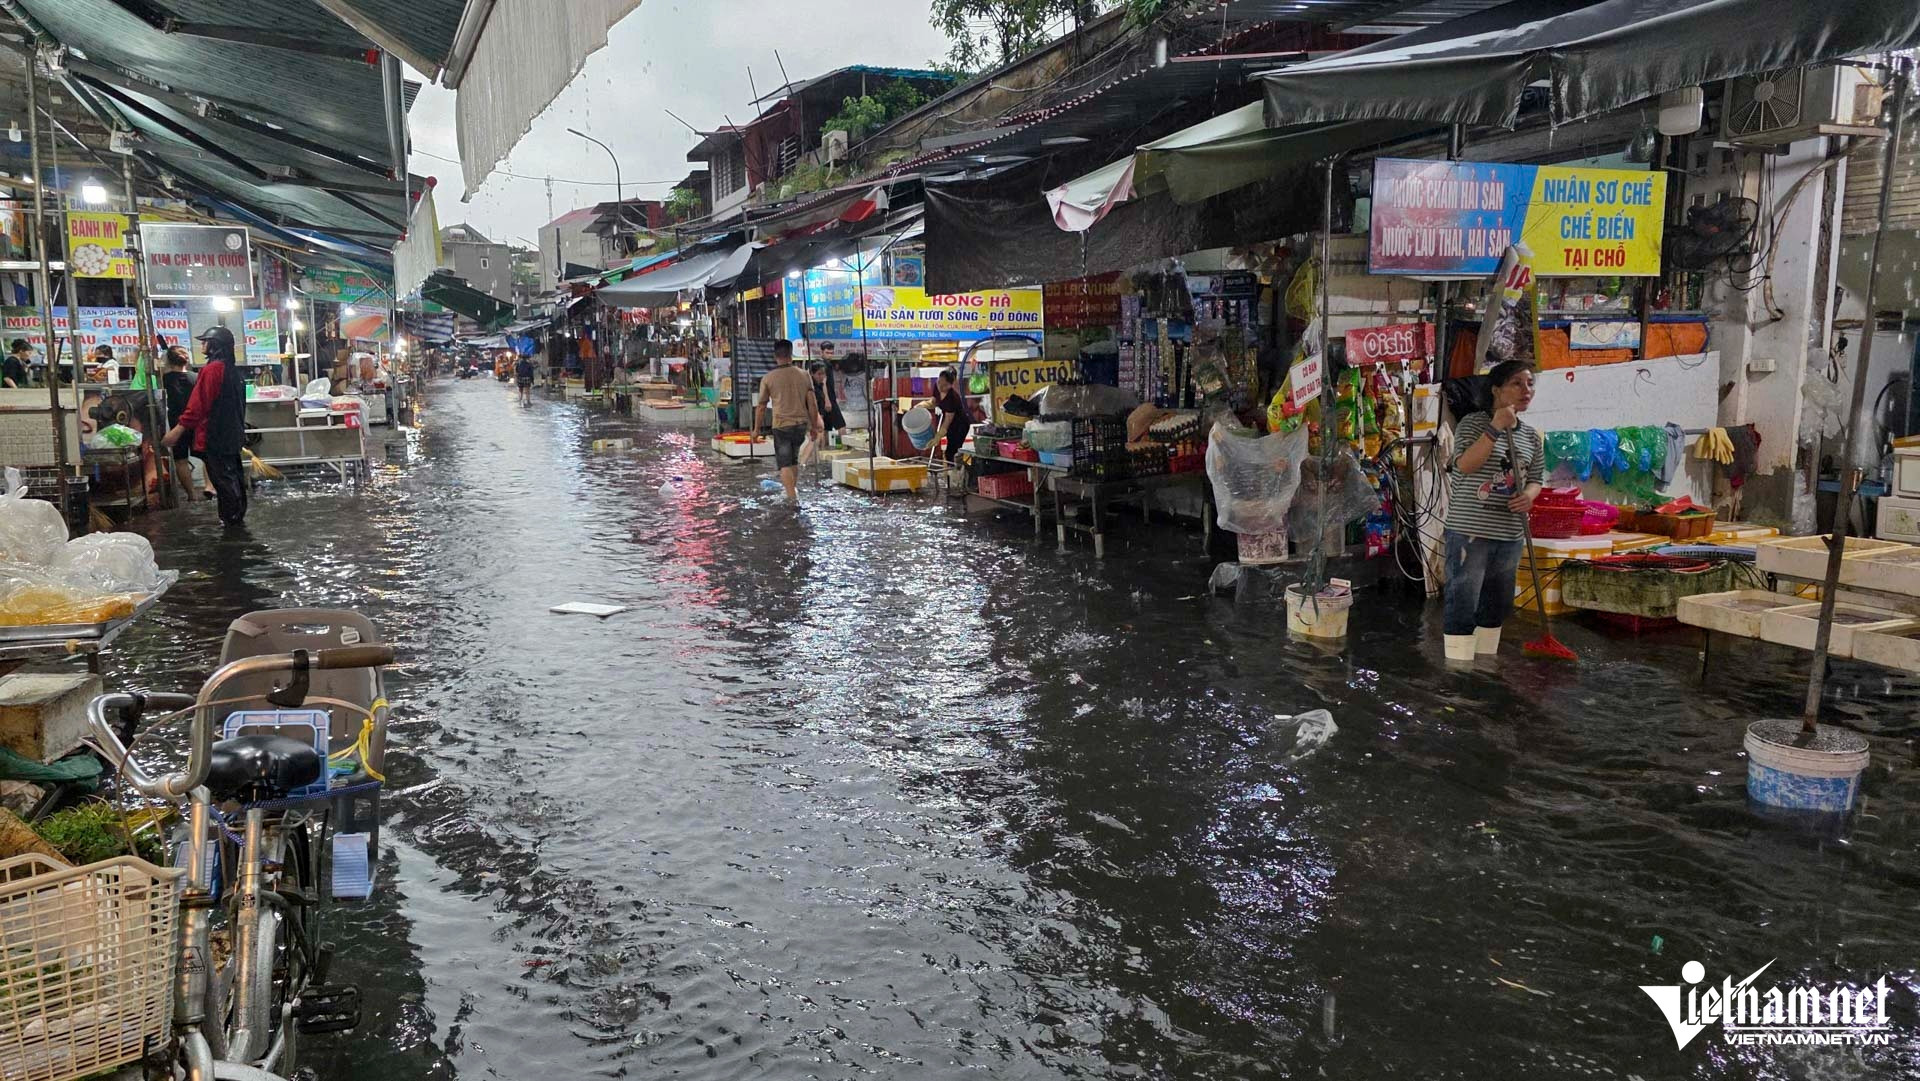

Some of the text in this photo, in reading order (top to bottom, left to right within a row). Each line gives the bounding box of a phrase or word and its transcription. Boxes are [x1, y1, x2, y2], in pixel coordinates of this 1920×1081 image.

[1461, 168, 1480, 210] HẢI
[1481, 169, 1505, 211] SẢN
[1543, 174, 1655, 208] NHẬN SƠ CHẾ
[71, 216, 100, 237] BÁNH
[1468, 216, 1486, 257] HẢI
[1488, 217, 1511, 257] SẢN
[1560, 208, 1635, 240] CHẾ BIẾN
[150, 253, 171, 266] KIM
[174, 253, 191, 266] CHI
[1564, 242, 1626, 271] TẠI CHỖ
[866, 305, 886, 320] HẢI
[890, 306, 915, 320] SẢN
[918, 310, 944, 321] TƯƠI
[947, 308, 978, 321] SỐNG
[1007, 310, 1038, 322] ĐÔNG
[990, 293, 1011, 307] HÀ
[1363, 330, 1415, 358] Oishi
[995, 367, 1030, 390] MỰC
